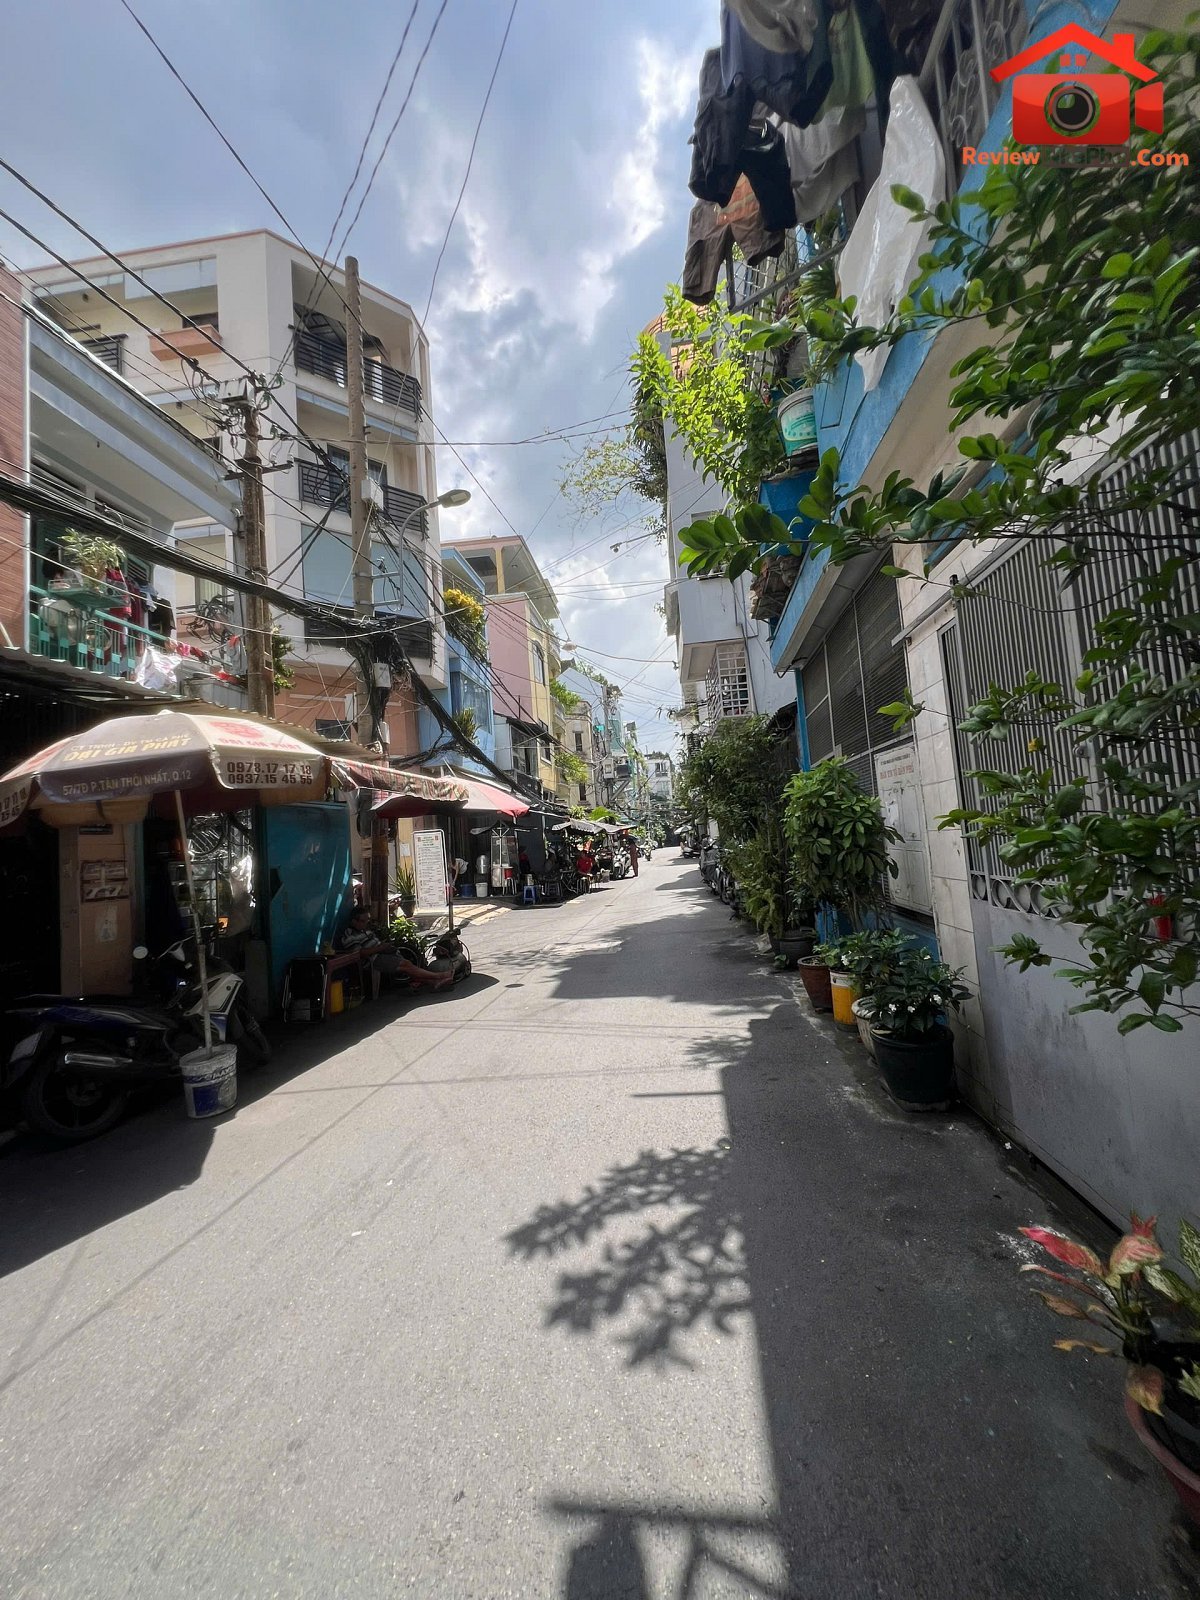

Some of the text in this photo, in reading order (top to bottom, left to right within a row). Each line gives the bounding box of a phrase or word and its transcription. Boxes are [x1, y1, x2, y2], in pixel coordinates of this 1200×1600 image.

[227, 761, 312, 775] 0978.17 17 18
[228, 773, 313, 785] 0937.15 45 55
